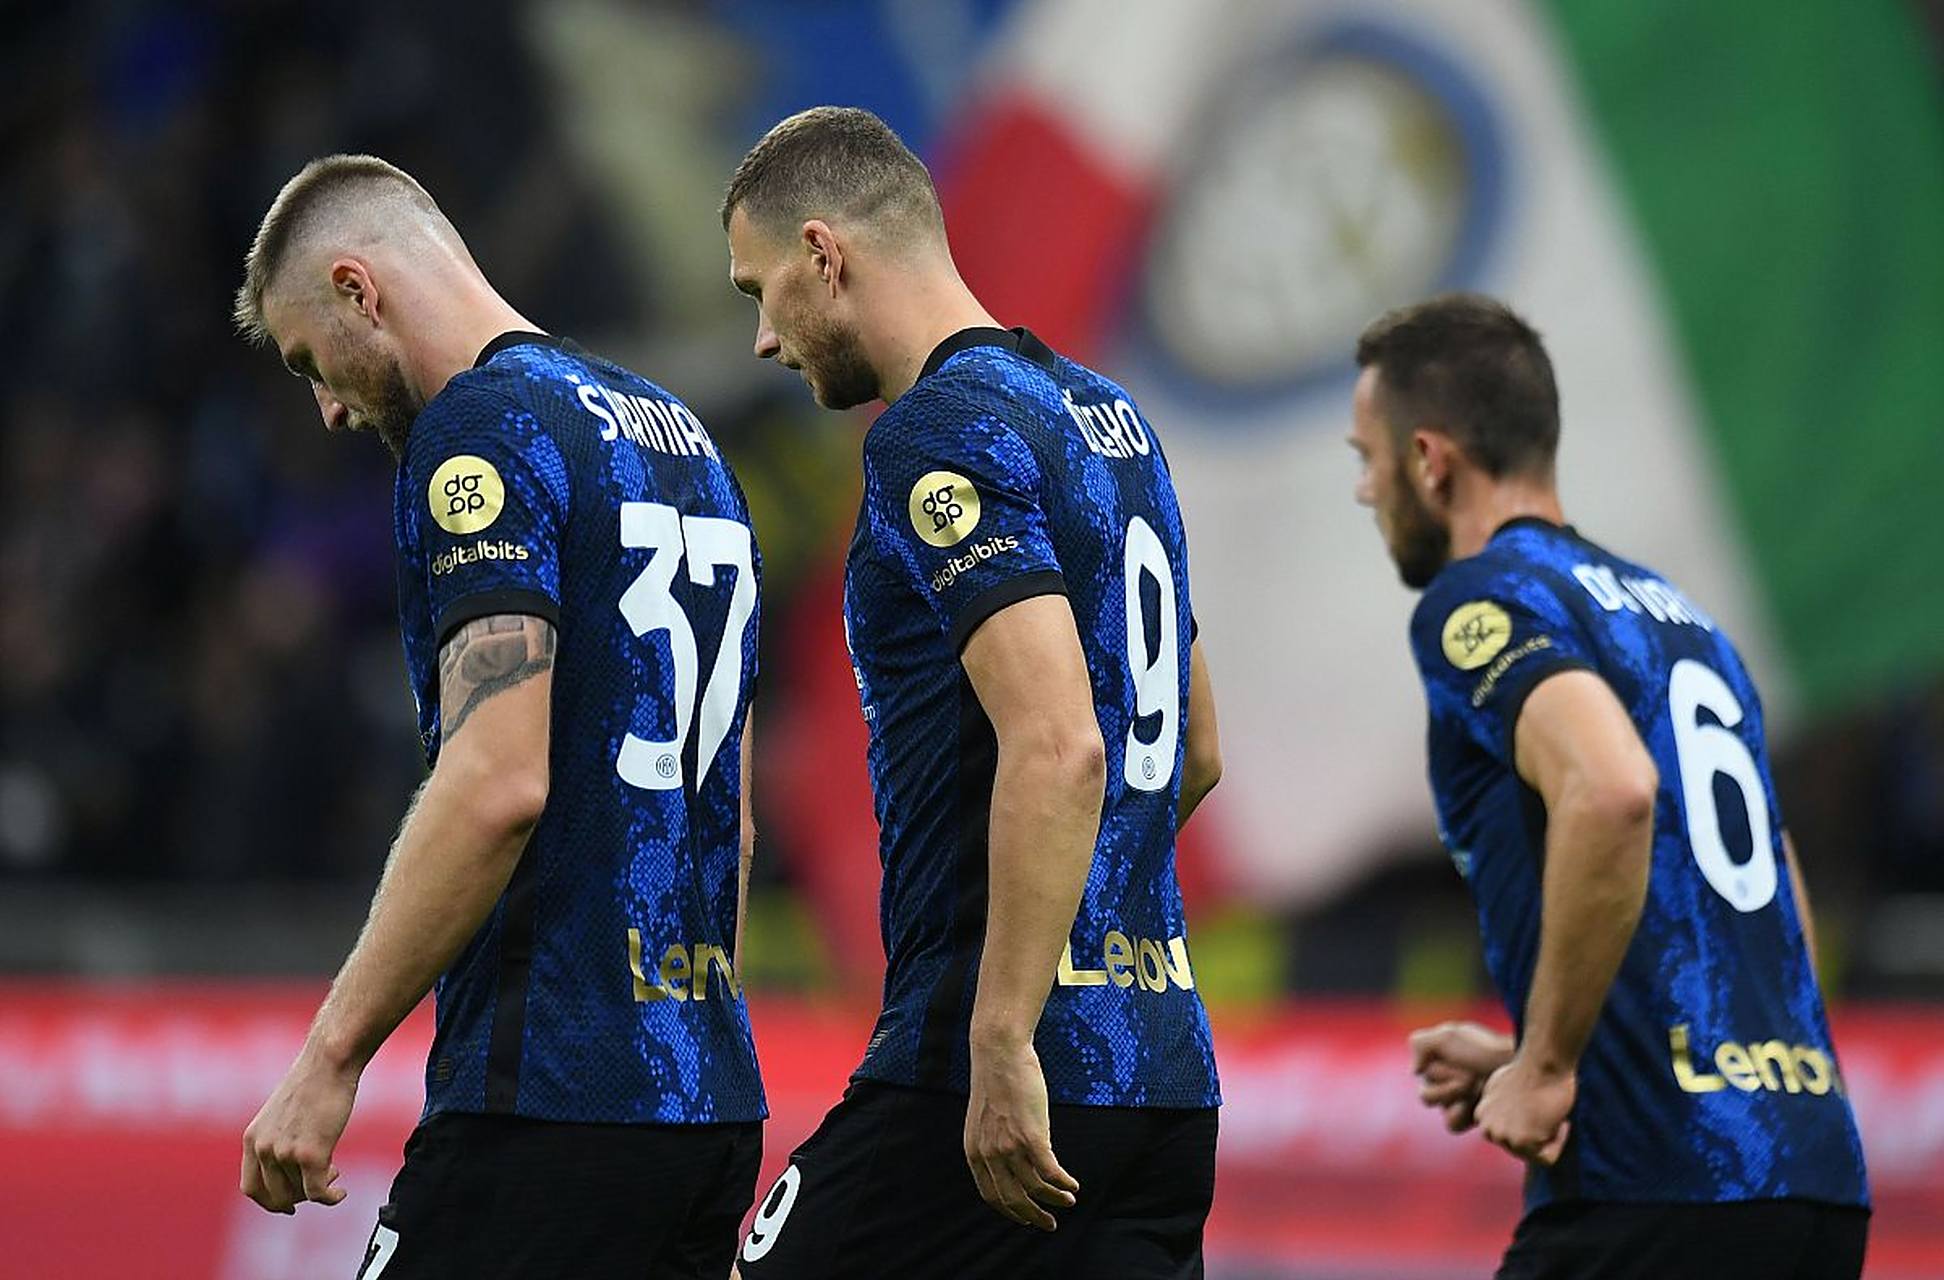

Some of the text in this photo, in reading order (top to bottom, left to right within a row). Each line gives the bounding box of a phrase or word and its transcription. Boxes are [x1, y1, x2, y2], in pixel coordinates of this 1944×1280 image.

[432, 540, 529, 575] digitalbits
[932, 535, 1019, 592] digitalbits
[616, 502, 758, 794] 37
[1124, 515, 1179, 792] 9
[1668, 658, 1778, 913] 6
[1668, 1023, 1838, 1095] Leno
[743, 1164, 801, 1262] 9
